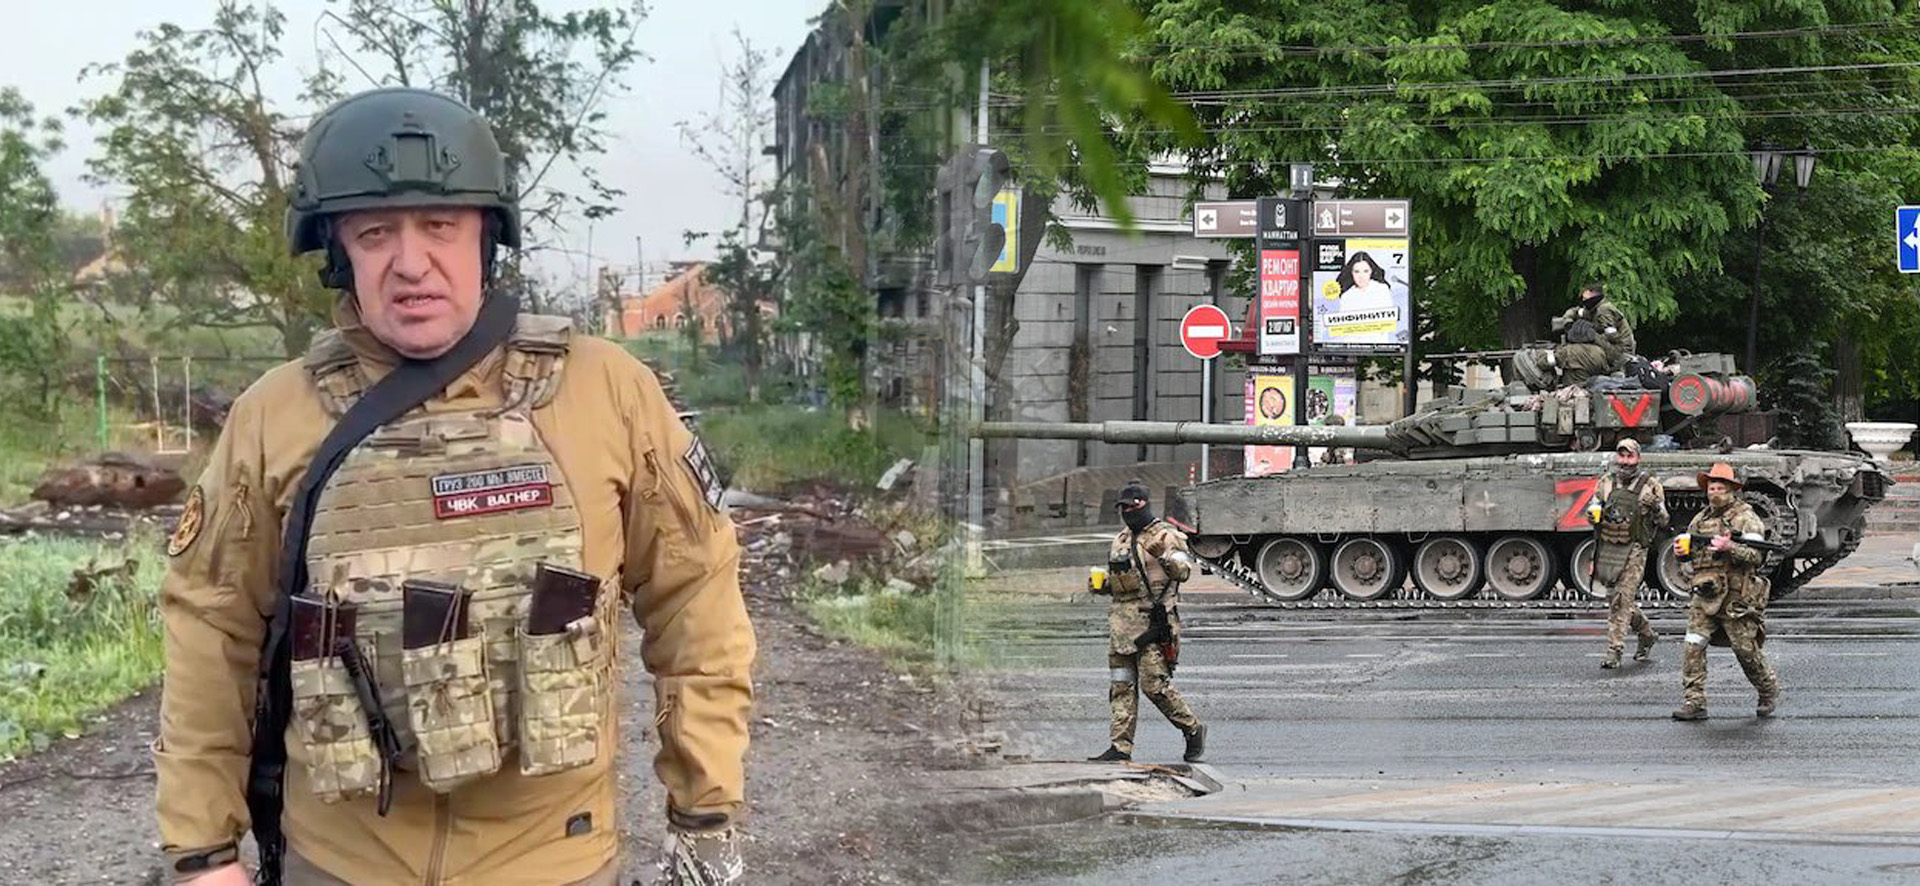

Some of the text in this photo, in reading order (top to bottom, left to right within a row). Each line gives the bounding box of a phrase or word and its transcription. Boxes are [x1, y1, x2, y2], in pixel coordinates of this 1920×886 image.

[1262, 259, 1298, 275] РЕМОНТ
[1393, 253, 1403, 264] 7
[1262, 280, 1298, 296] КВАРТИР
[1328, 311, 1396, 323] ИНФИНИТИ
[1608, 394, 1653, 427] V
[439, 469, 543, 492] ГРУЗ 200 МЫ ВМЕСТЕ
[448, 489, 540, 512] ЧВК ВАГНЕР
[1554, 476, 1599, 530] Z
